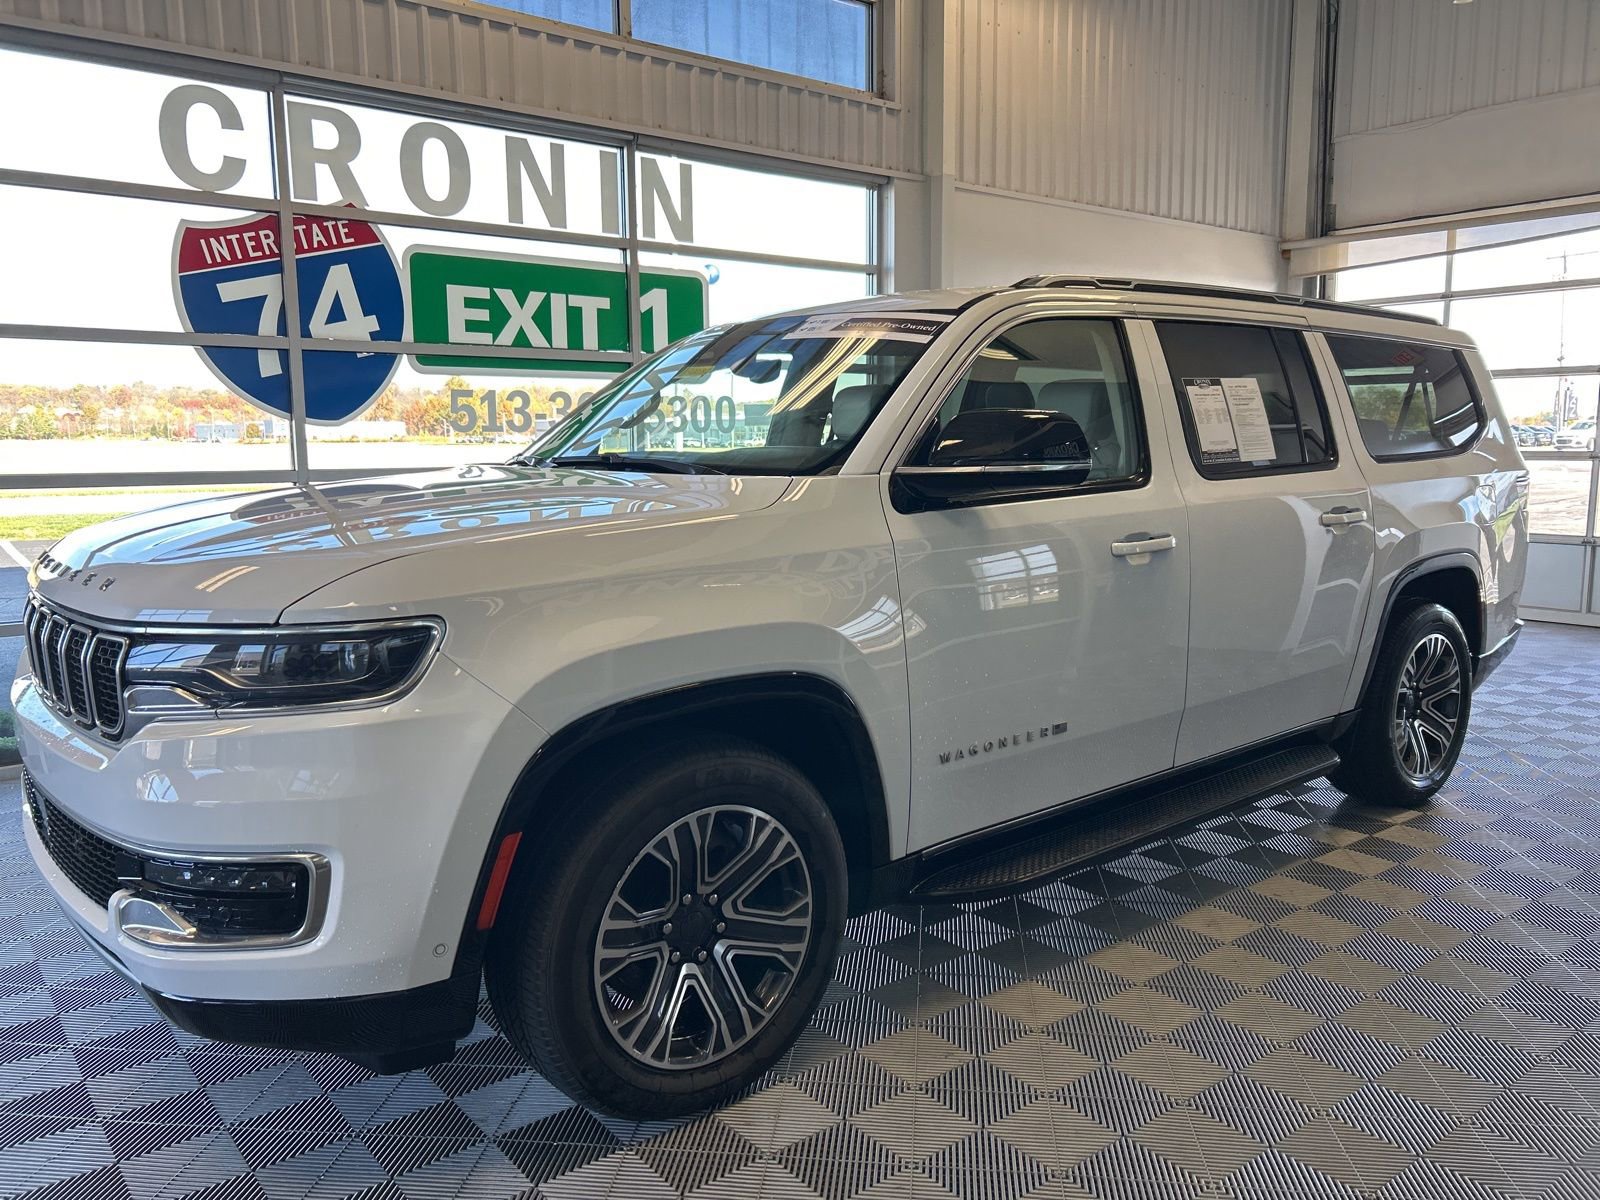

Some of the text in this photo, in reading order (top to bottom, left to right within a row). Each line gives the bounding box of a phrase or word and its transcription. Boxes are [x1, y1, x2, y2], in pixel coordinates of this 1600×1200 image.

[159, 84, 694, 244] CRONIN
[200, 220, 355, 265] INTERTATE
[216, 263, 380, 379] 74
[446, 284, 668, 354] EXIT 1
[840, 318, 885, 329] Certified
[884, 320, 936, 331] Pre-Owned
[939, 726, 1049, 764] WAGONEER
